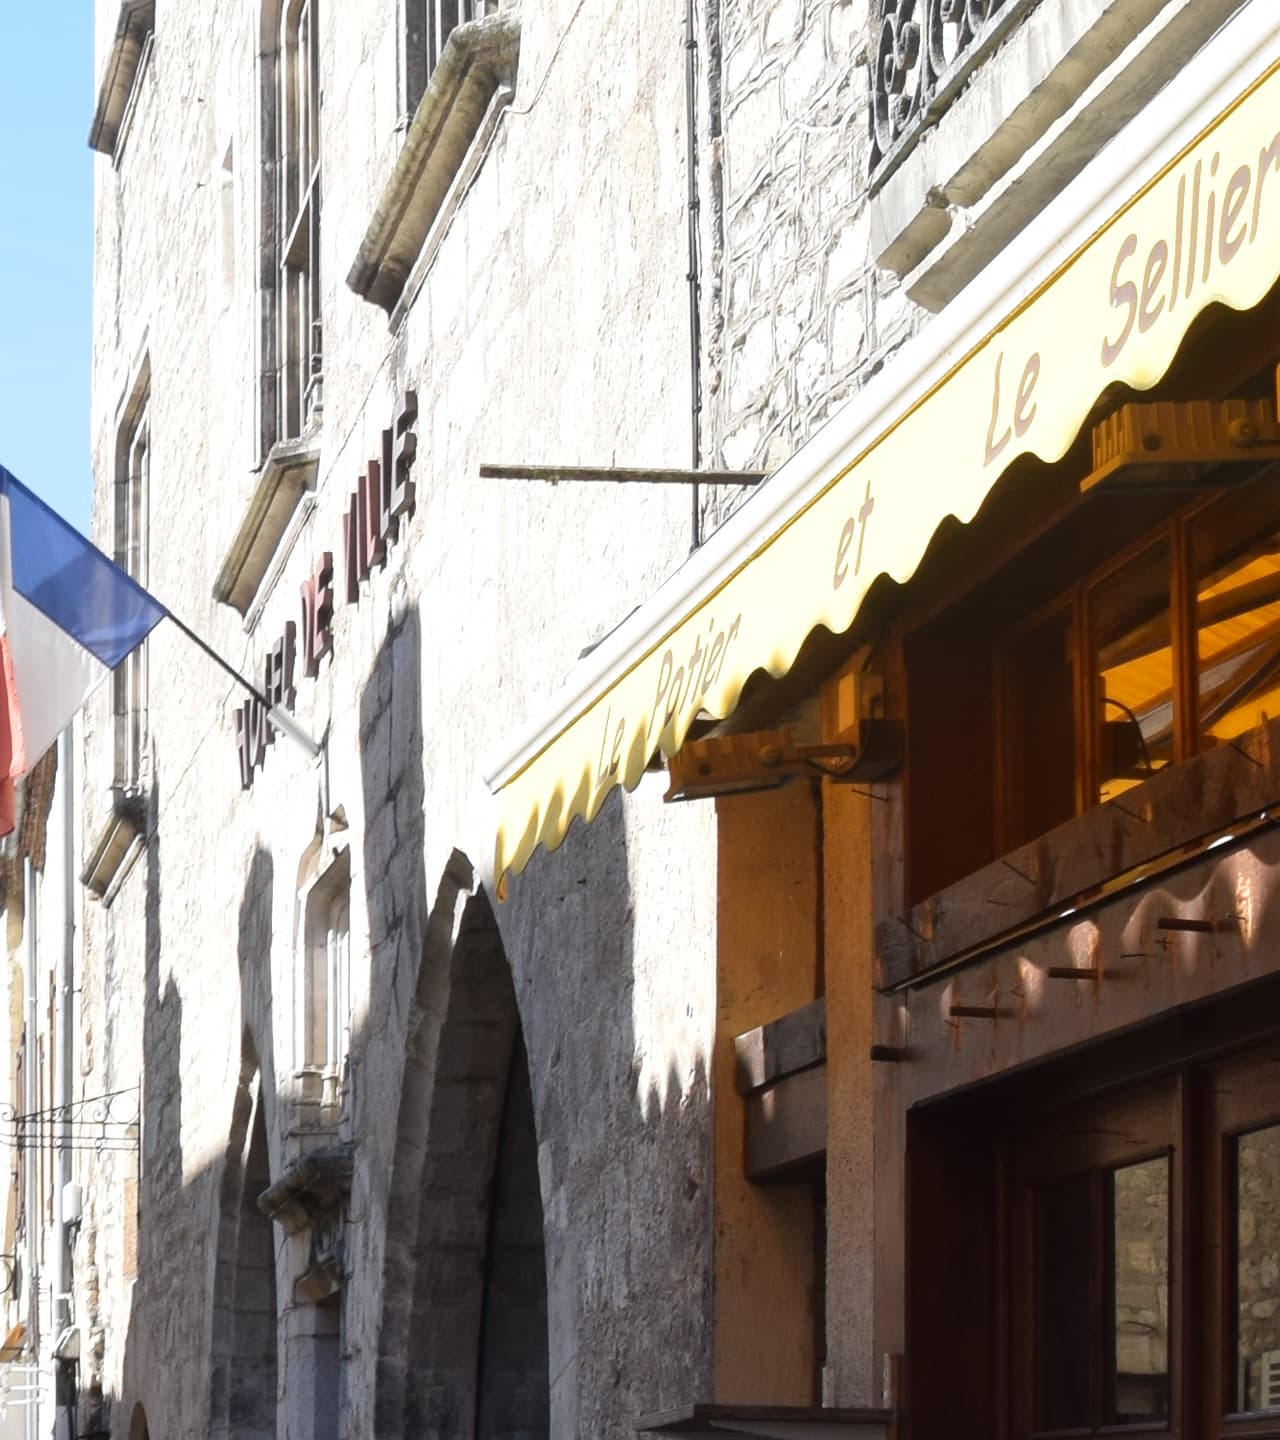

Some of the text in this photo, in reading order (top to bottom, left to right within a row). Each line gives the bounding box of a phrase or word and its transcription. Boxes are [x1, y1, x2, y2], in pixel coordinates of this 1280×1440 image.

[300, 551, 334, 678] DE
[343, 390, 419, 605] VILLE
[595, 130, 1280, 790] Le Potier et Le Sellier
